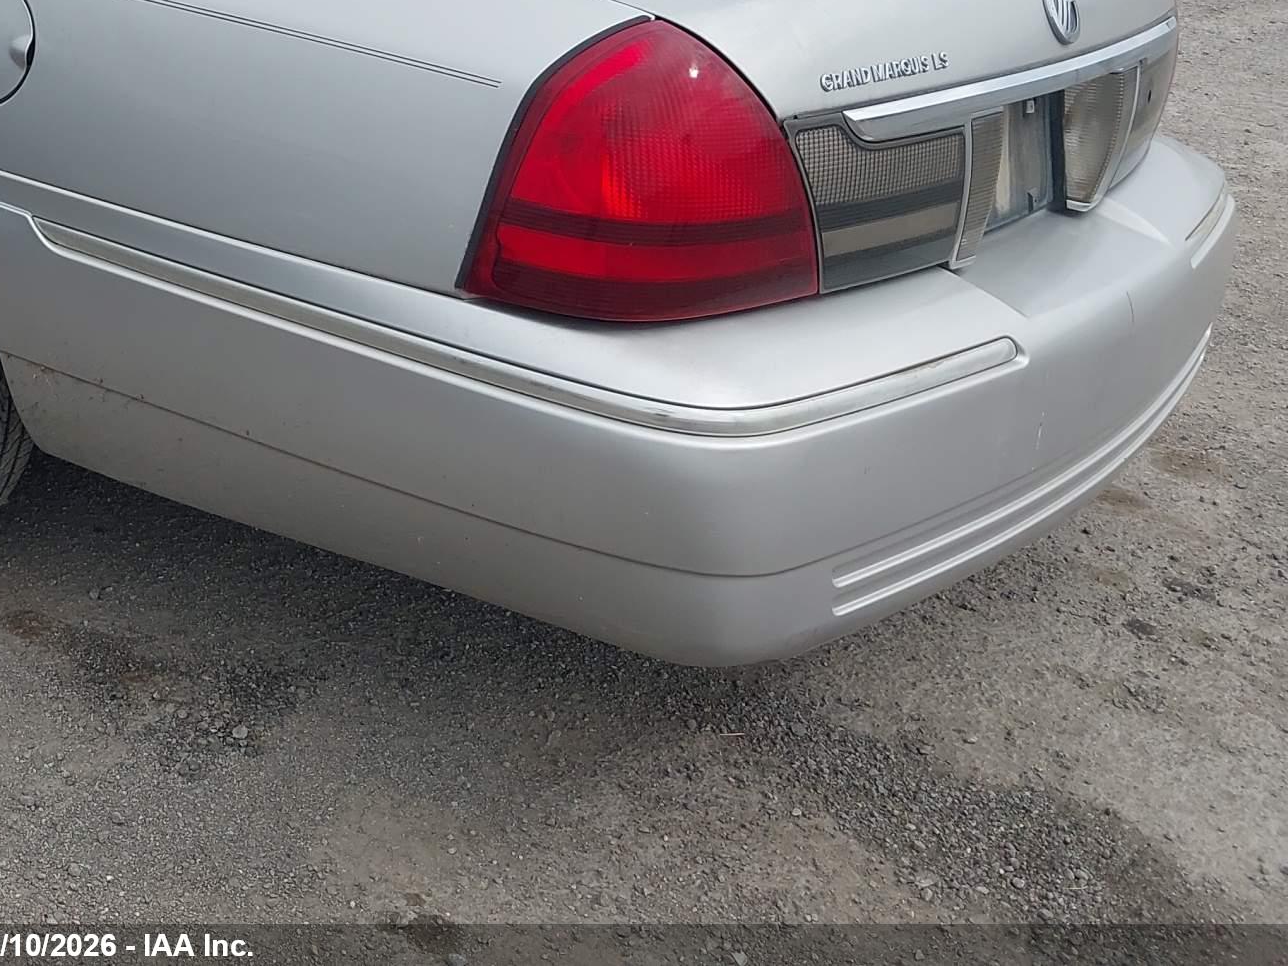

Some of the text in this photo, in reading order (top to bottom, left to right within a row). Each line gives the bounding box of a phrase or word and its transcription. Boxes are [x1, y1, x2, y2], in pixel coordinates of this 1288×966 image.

[820, 51, 949, 92] GRAND MARQUIS LS
